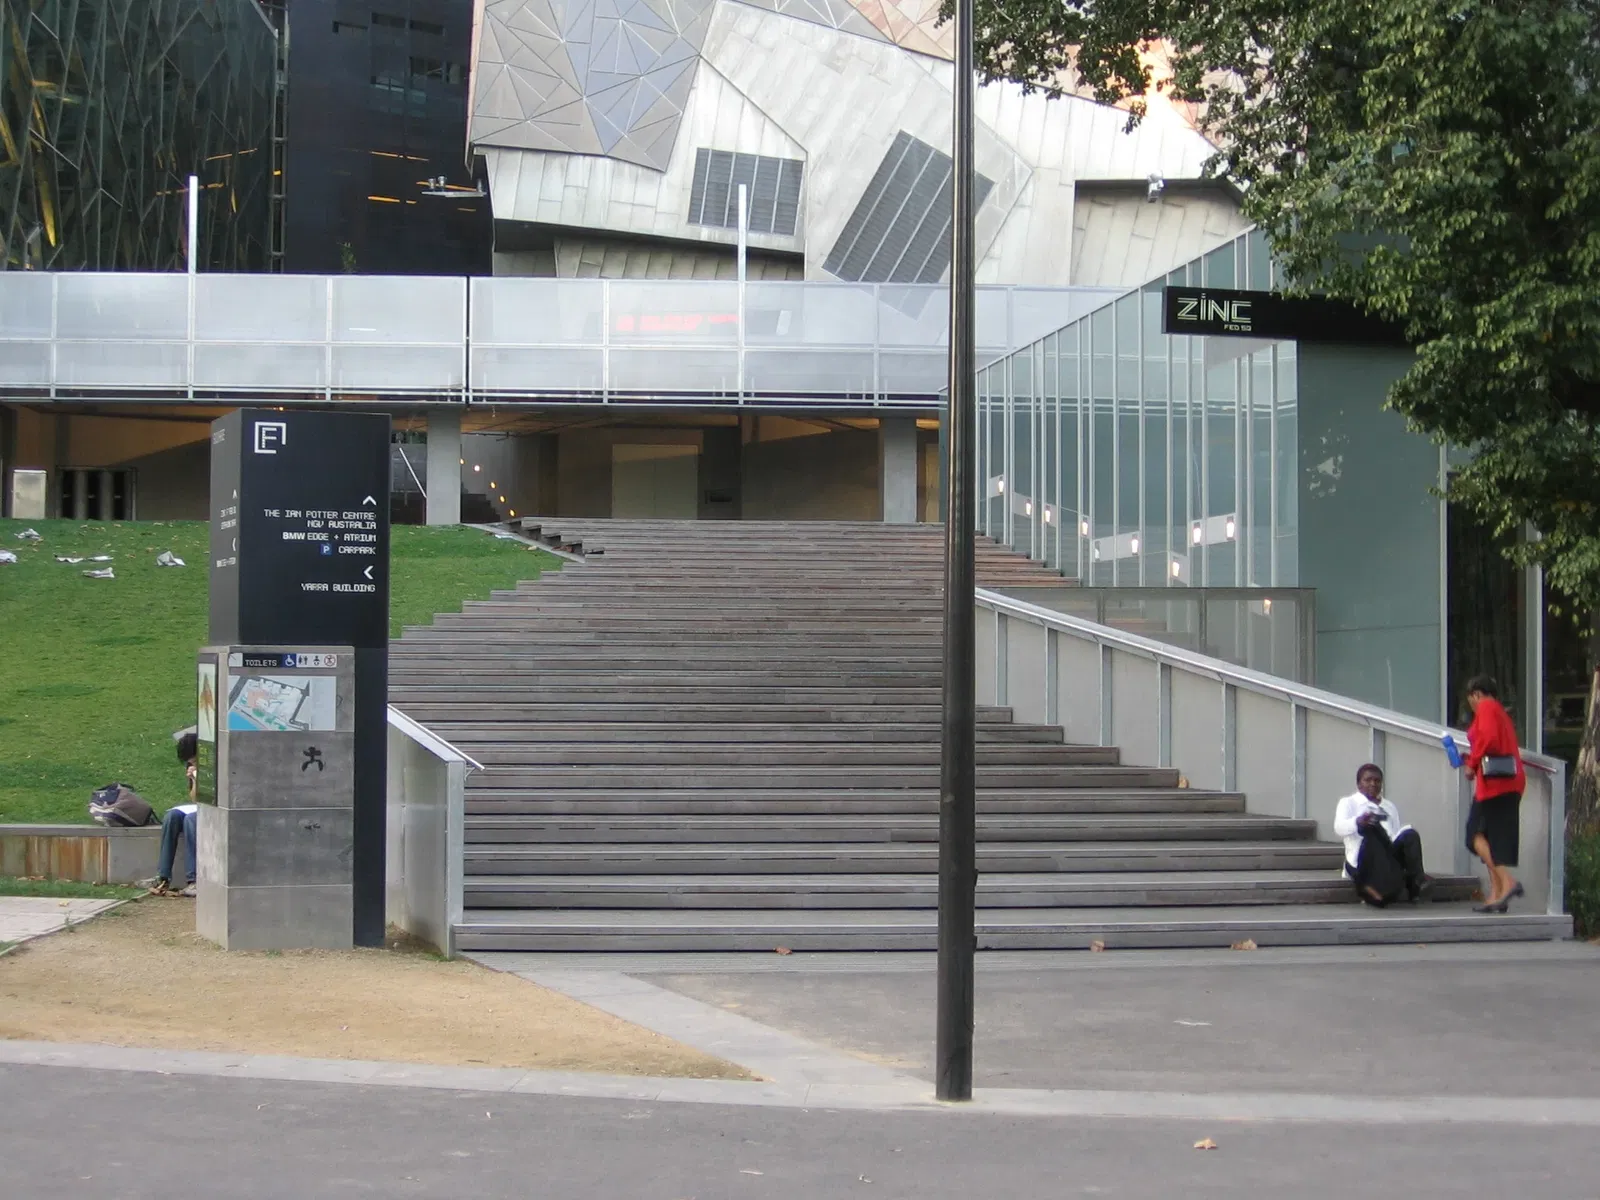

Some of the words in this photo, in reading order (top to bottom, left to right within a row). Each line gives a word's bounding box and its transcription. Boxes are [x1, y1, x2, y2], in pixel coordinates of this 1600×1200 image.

[264, 509, 280, 518] THE
[285, 509, 302, 518] IAN
[306, 511, 339, 519] POTTER
[307, 520, 324, 528] NGV
[328, 521, 377, 530] AUSTRALIA
[282, 532, 306, 540] BMW
[344, 534, 377, 542] ATRIUM
[338, 546, 376, 555] CARPARK
[301, 583, 329, 591] YARRA
[333, 584, 376, 592] BUILDING
